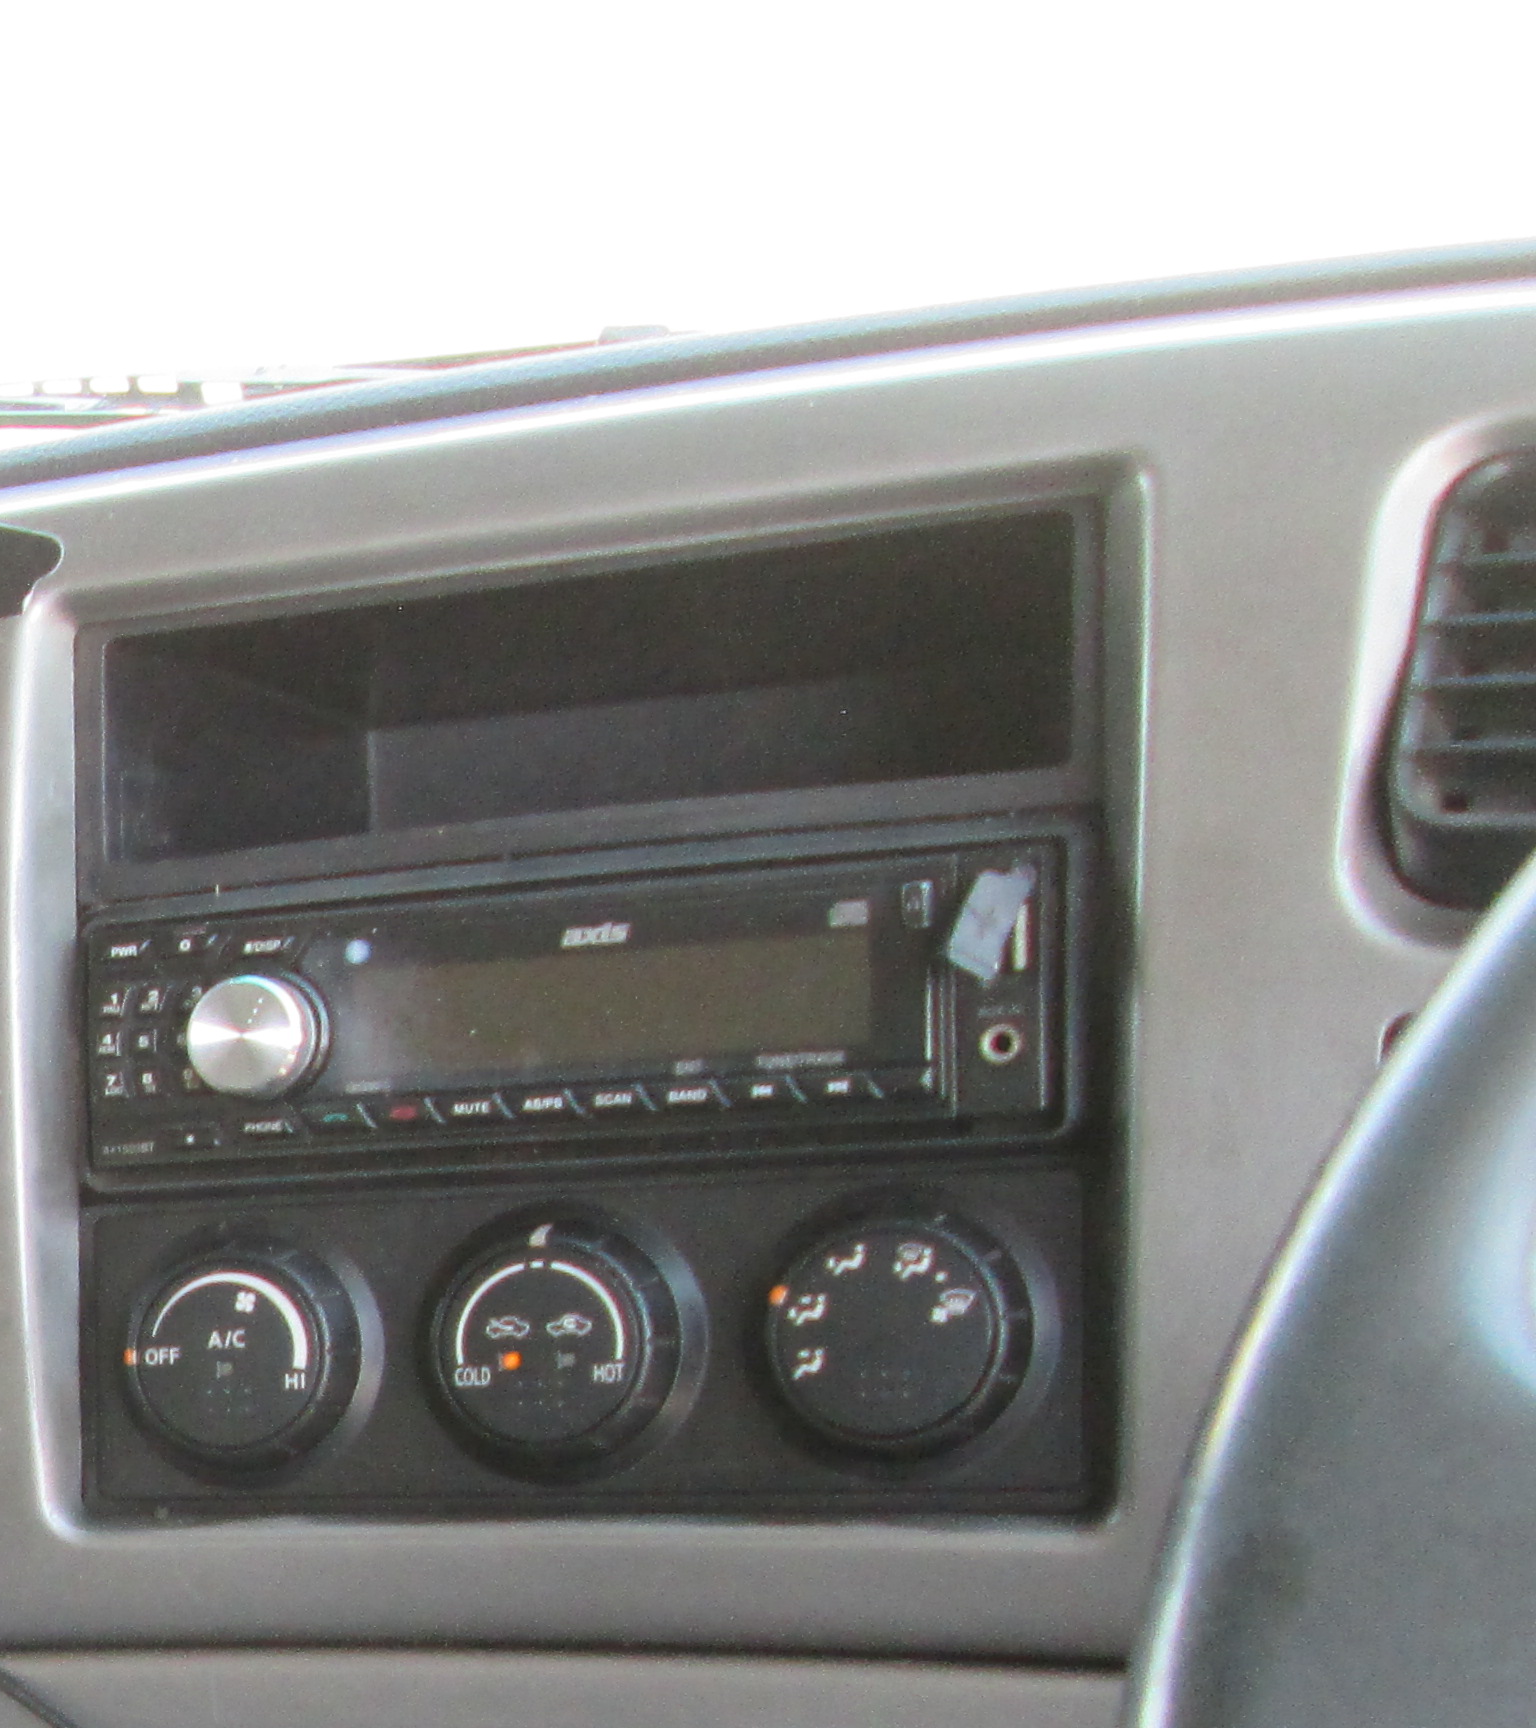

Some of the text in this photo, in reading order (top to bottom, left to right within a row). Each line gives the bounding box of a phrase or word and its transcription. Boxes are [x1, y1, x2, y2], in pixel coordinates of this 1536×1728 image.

[452, 1101, 490, 1116] MUTE
[594, 1091, 633, 1107] SCAN
[207, 1329, 247, 1350] A/C
[144, 1347, 181, 1366] OFF
[284, 1372, 306, 1390] HI
[454, 1366, 491, 1387] COLD
[593, 1362, 625, 1383] HOT
